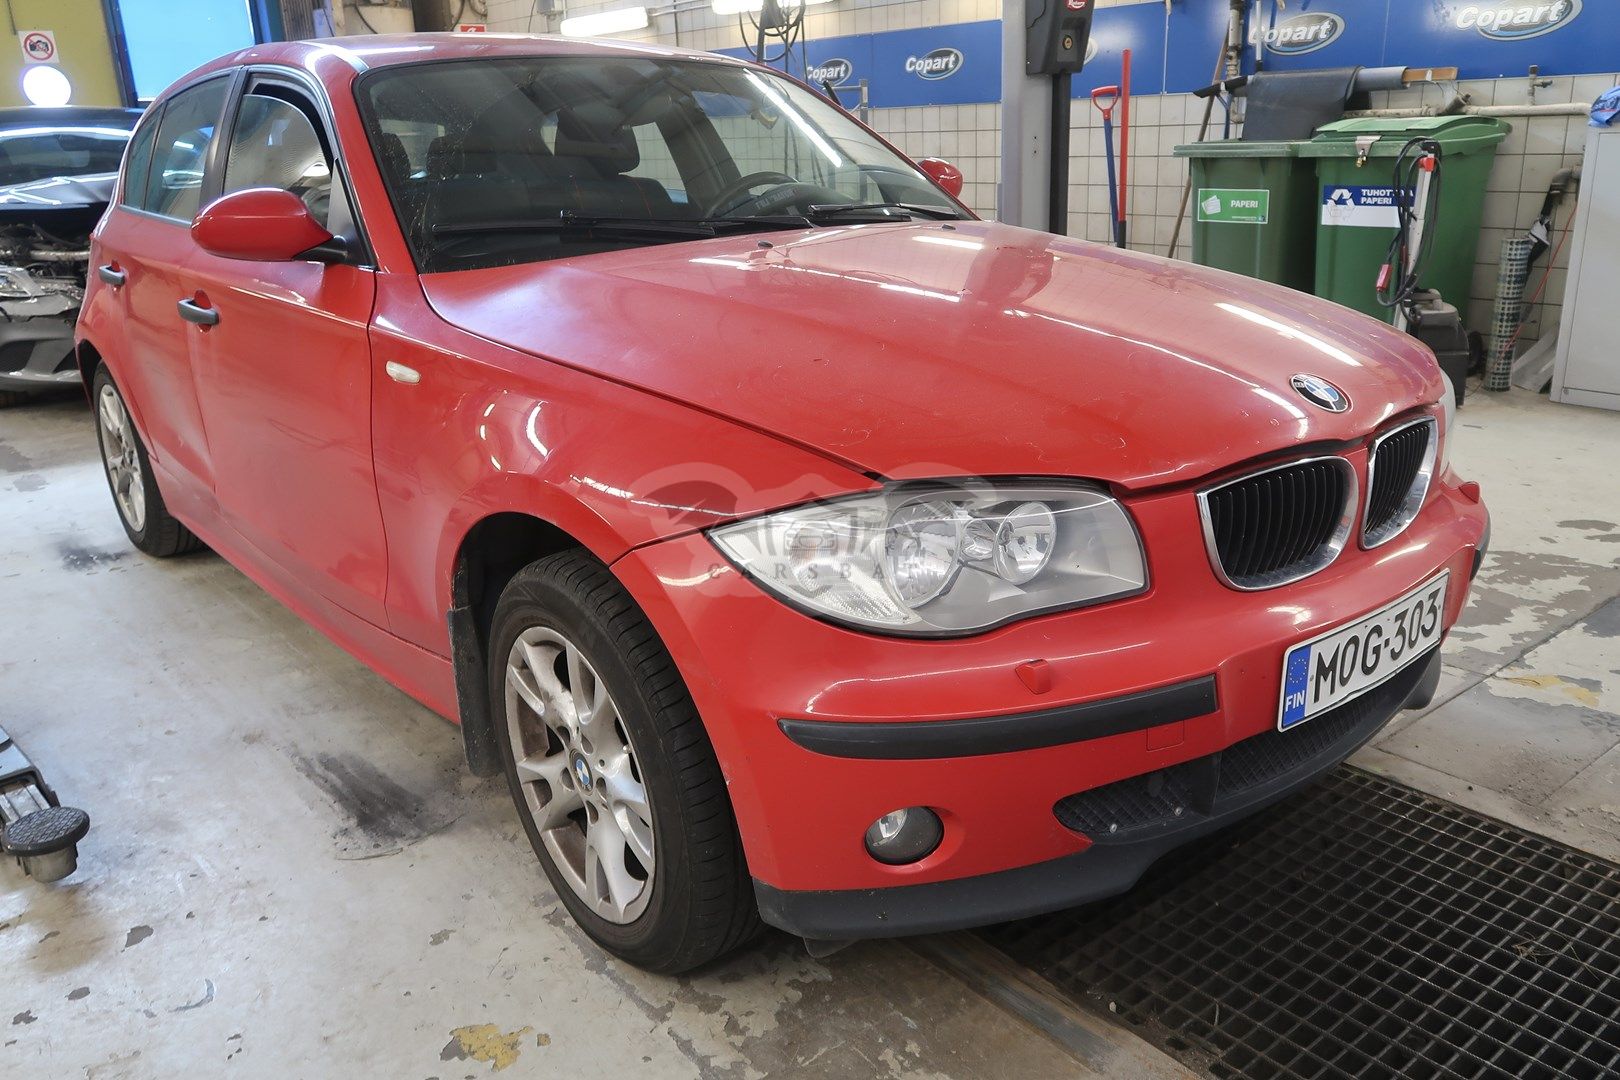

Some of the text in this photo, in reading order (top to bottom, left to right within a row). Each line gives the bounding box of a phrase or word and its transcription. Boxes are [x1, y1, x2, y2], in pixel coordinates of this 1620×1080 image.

[1456, 0, 1567, 32] Copart
[806, 63, 846, 82] Copart
[905, 53, 956, 74] Copart
[1230, 200, 1259, 208] PAPERI
[1361, 197, 1393, 206] PAPERI
[1313, 587, 1442, 703] MOG-303
[1285, 690, 1305, 712] FIN
